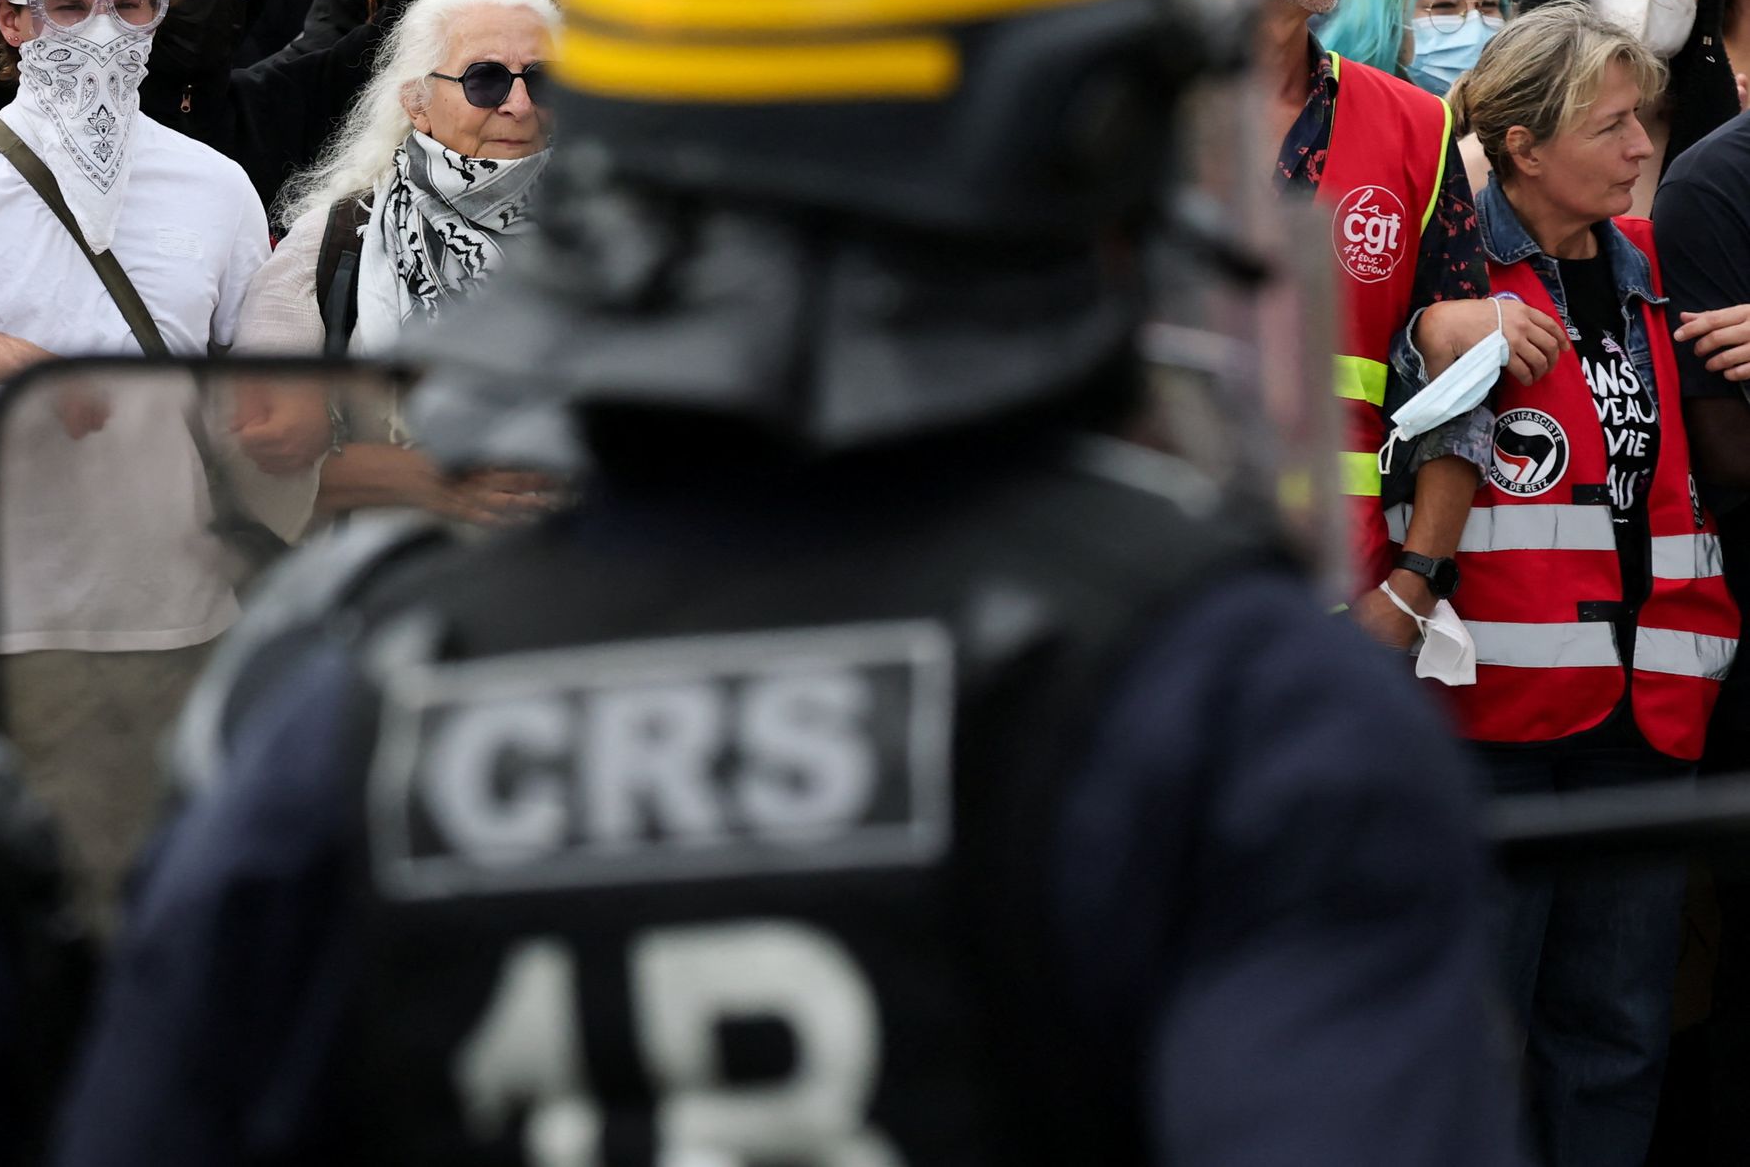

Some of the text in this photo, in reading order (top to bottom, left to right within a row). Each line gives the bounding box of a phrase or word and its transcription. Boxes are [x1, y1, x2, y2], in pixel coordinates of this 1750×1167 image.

[1348, 188, 1401, 220] la
[1343, 213, 1401, 255] cgt
[1343, 243, 1362, 256] 44
[1357, 262, 1386, 275] ACTION
[1498, 411, 1564, 444] ANTIFASCISTE
[1490, 465, 1550, 493] PAYS DE RETZ
[430, 672, 872, 864] CRS
